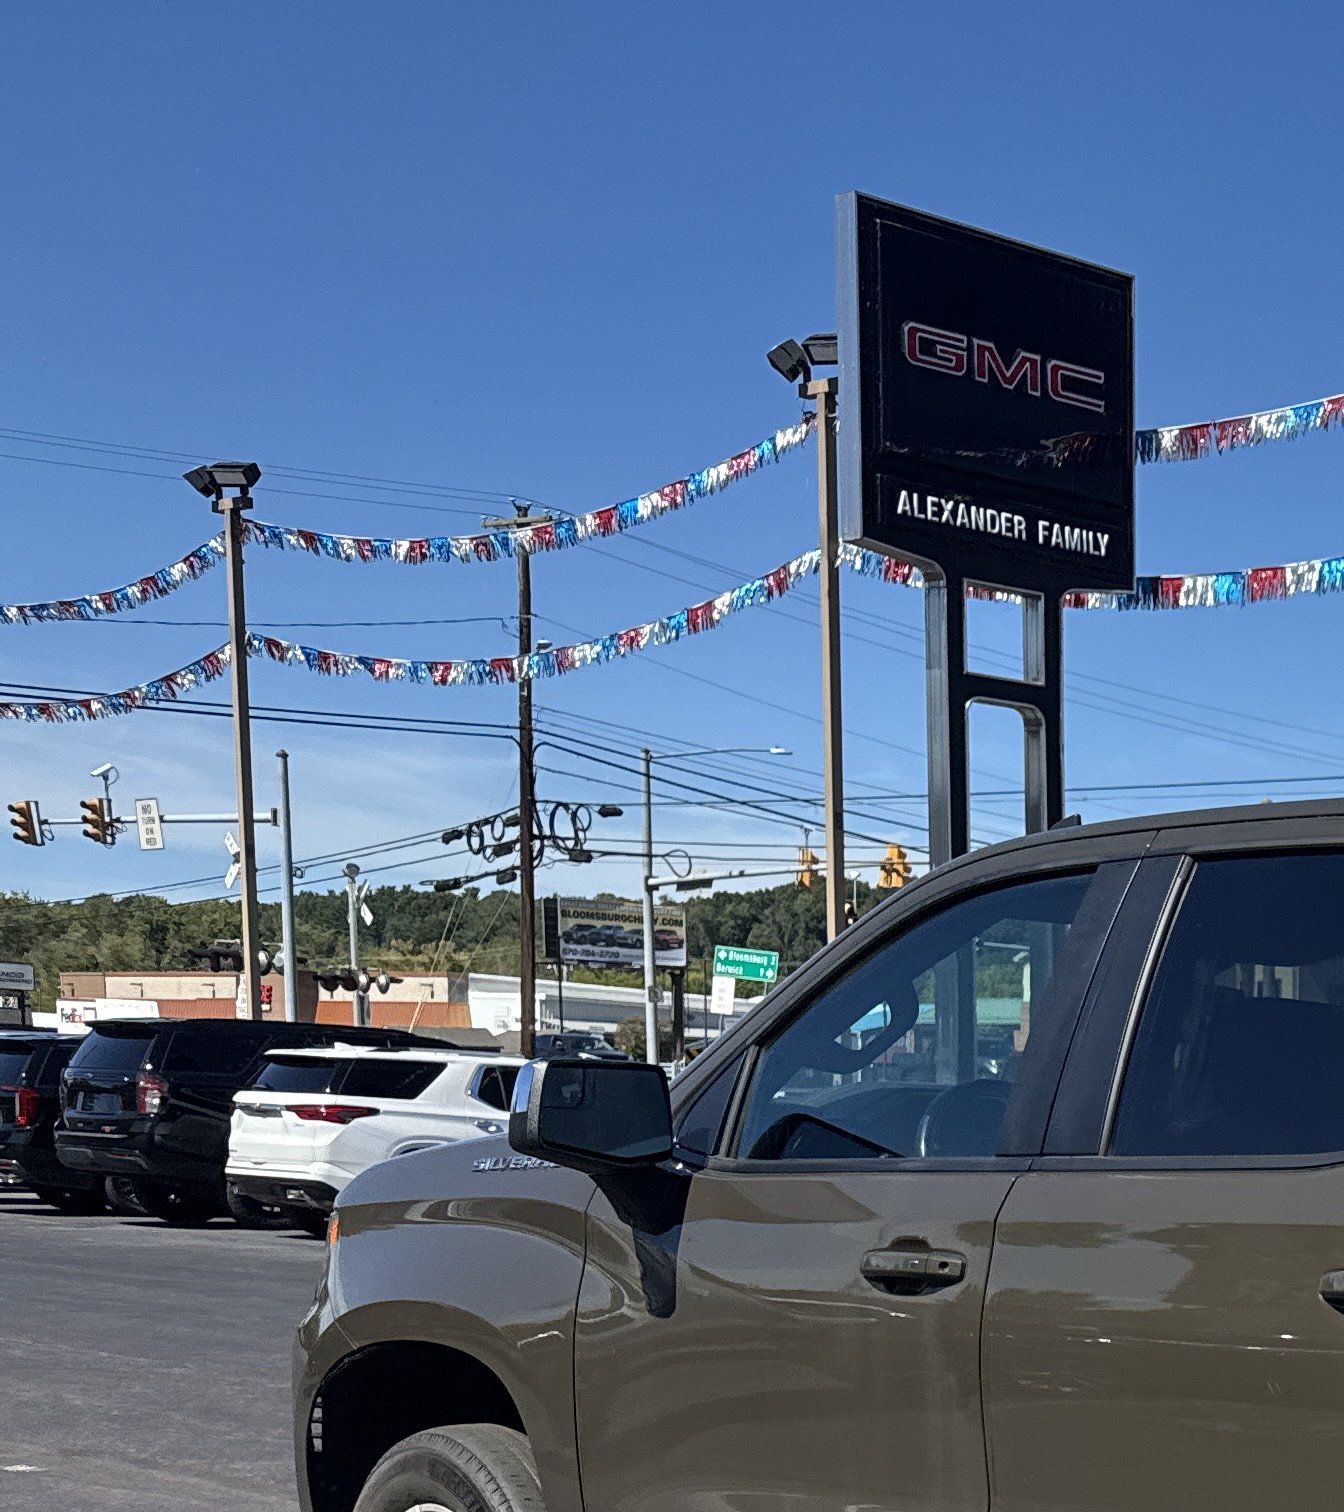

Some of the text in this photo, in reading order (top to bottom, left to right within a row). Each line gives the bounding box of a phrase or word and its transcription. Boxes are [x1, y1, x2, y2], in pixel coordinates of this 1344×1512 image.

[903, 321, 1105, 413] GMC
[897, 490, 1109, 557] ALEXANDER FAMILY
[141, 803, 152, 815] NO
[145, 827, 154, 836] ON
